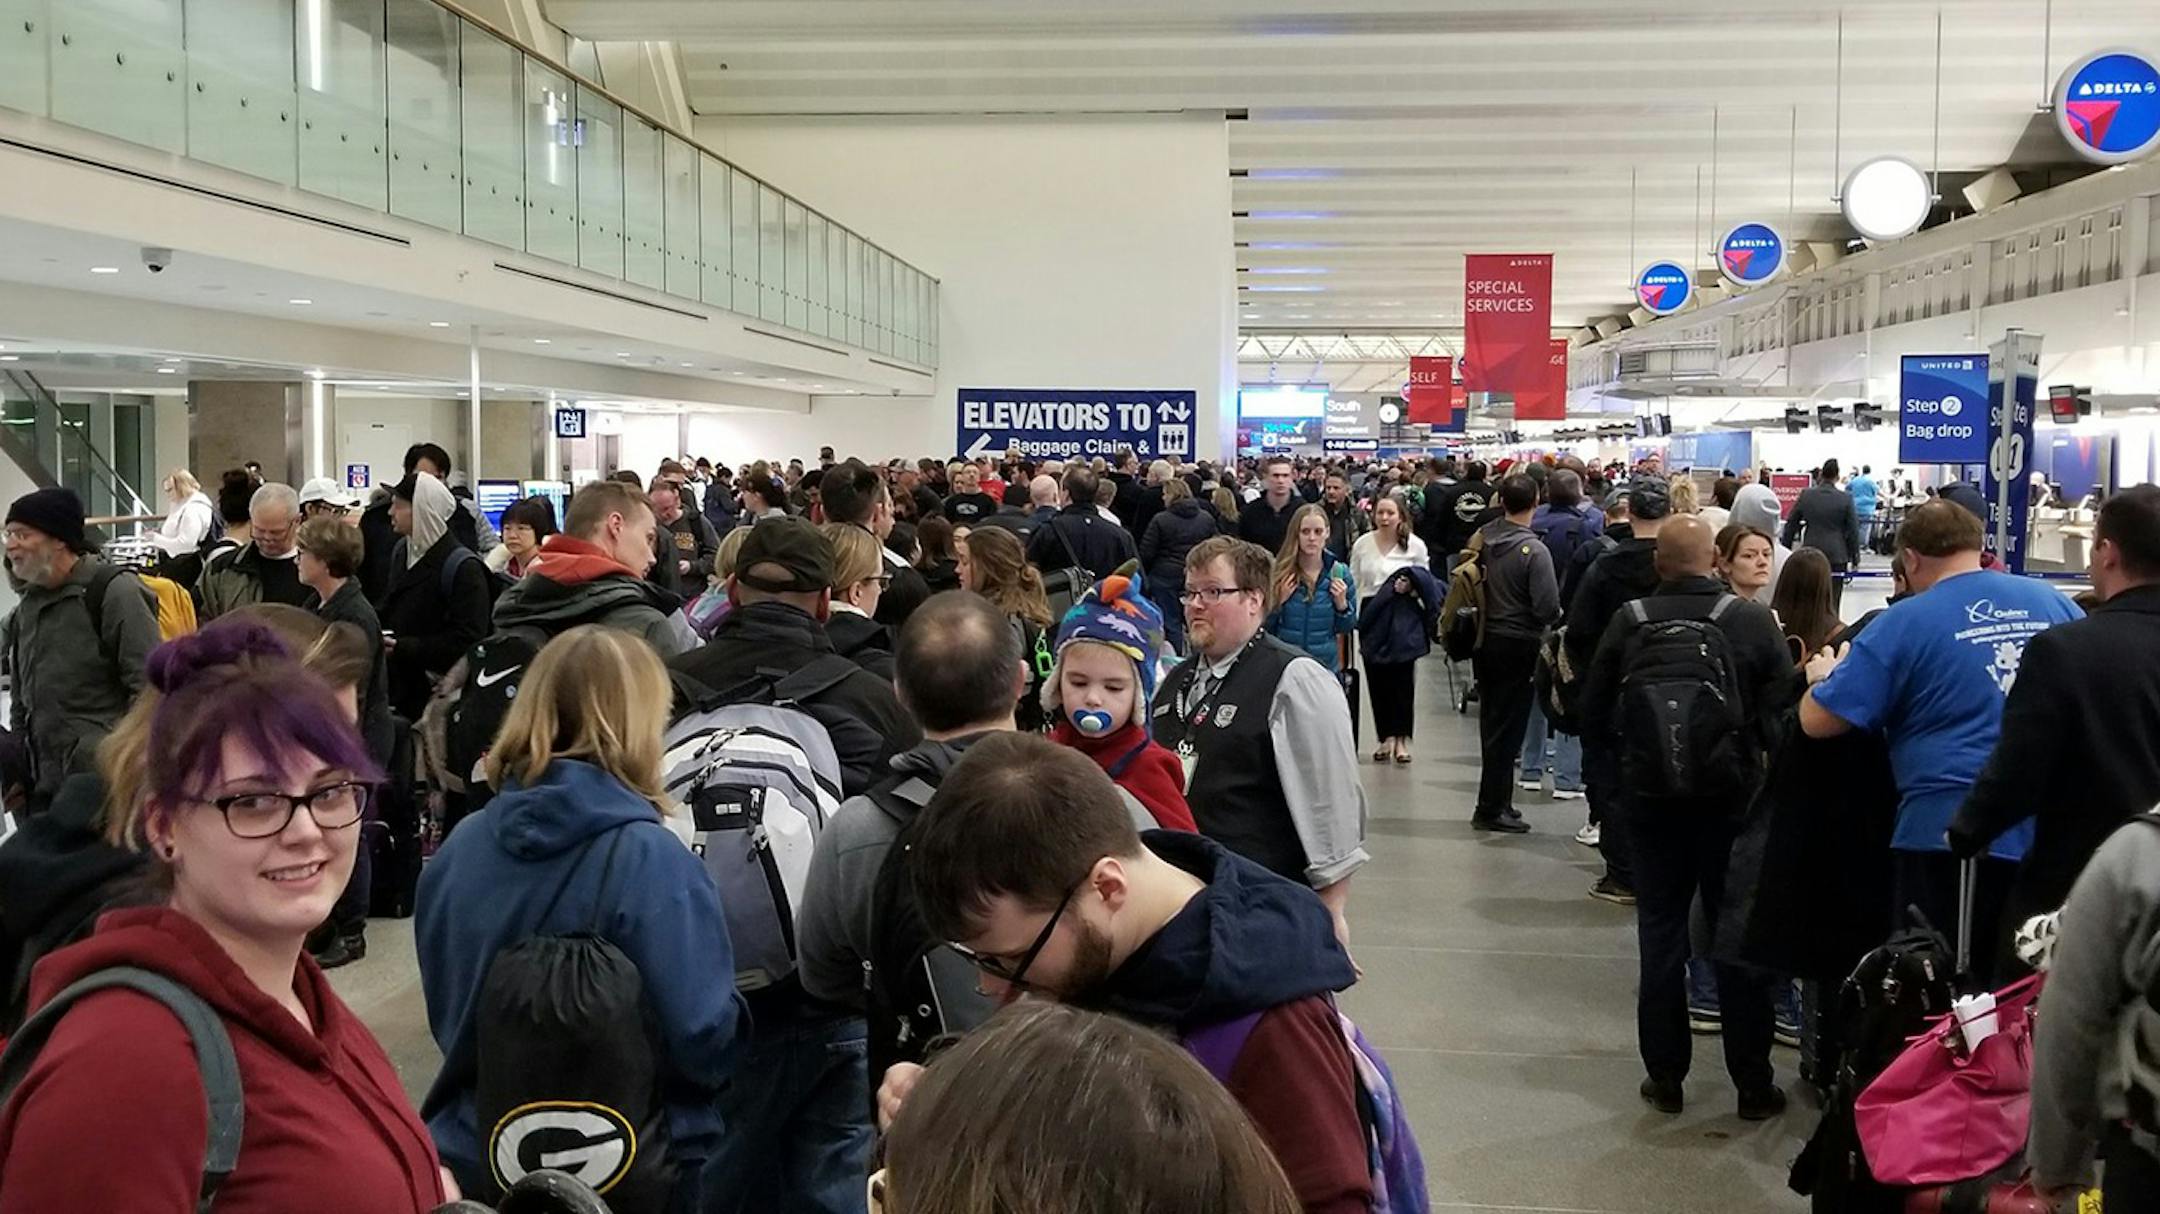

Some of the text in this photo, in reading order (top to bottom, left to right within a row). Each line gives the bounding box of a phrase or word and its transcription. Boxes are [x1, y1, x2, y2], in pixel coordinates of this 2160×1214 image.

[2094, 83, 2142, 94] DELTA
[1739, 240, 1767, 248] DELTA
[1467, 280, 1526, 294] SPECIAL
[1467, 298, 1535, 312] SERVICES
[1411, 371, 1438, 383] SELF
[1906, 398, 1939, 415] Step
[963, 401, 1151, 432] ELEVATORS TO
[1906, 423, 1973, 439] Bag drop
[1008, 437, 1150, 456] Baggage Claim &
[497, 1111, 624, 1189] G
